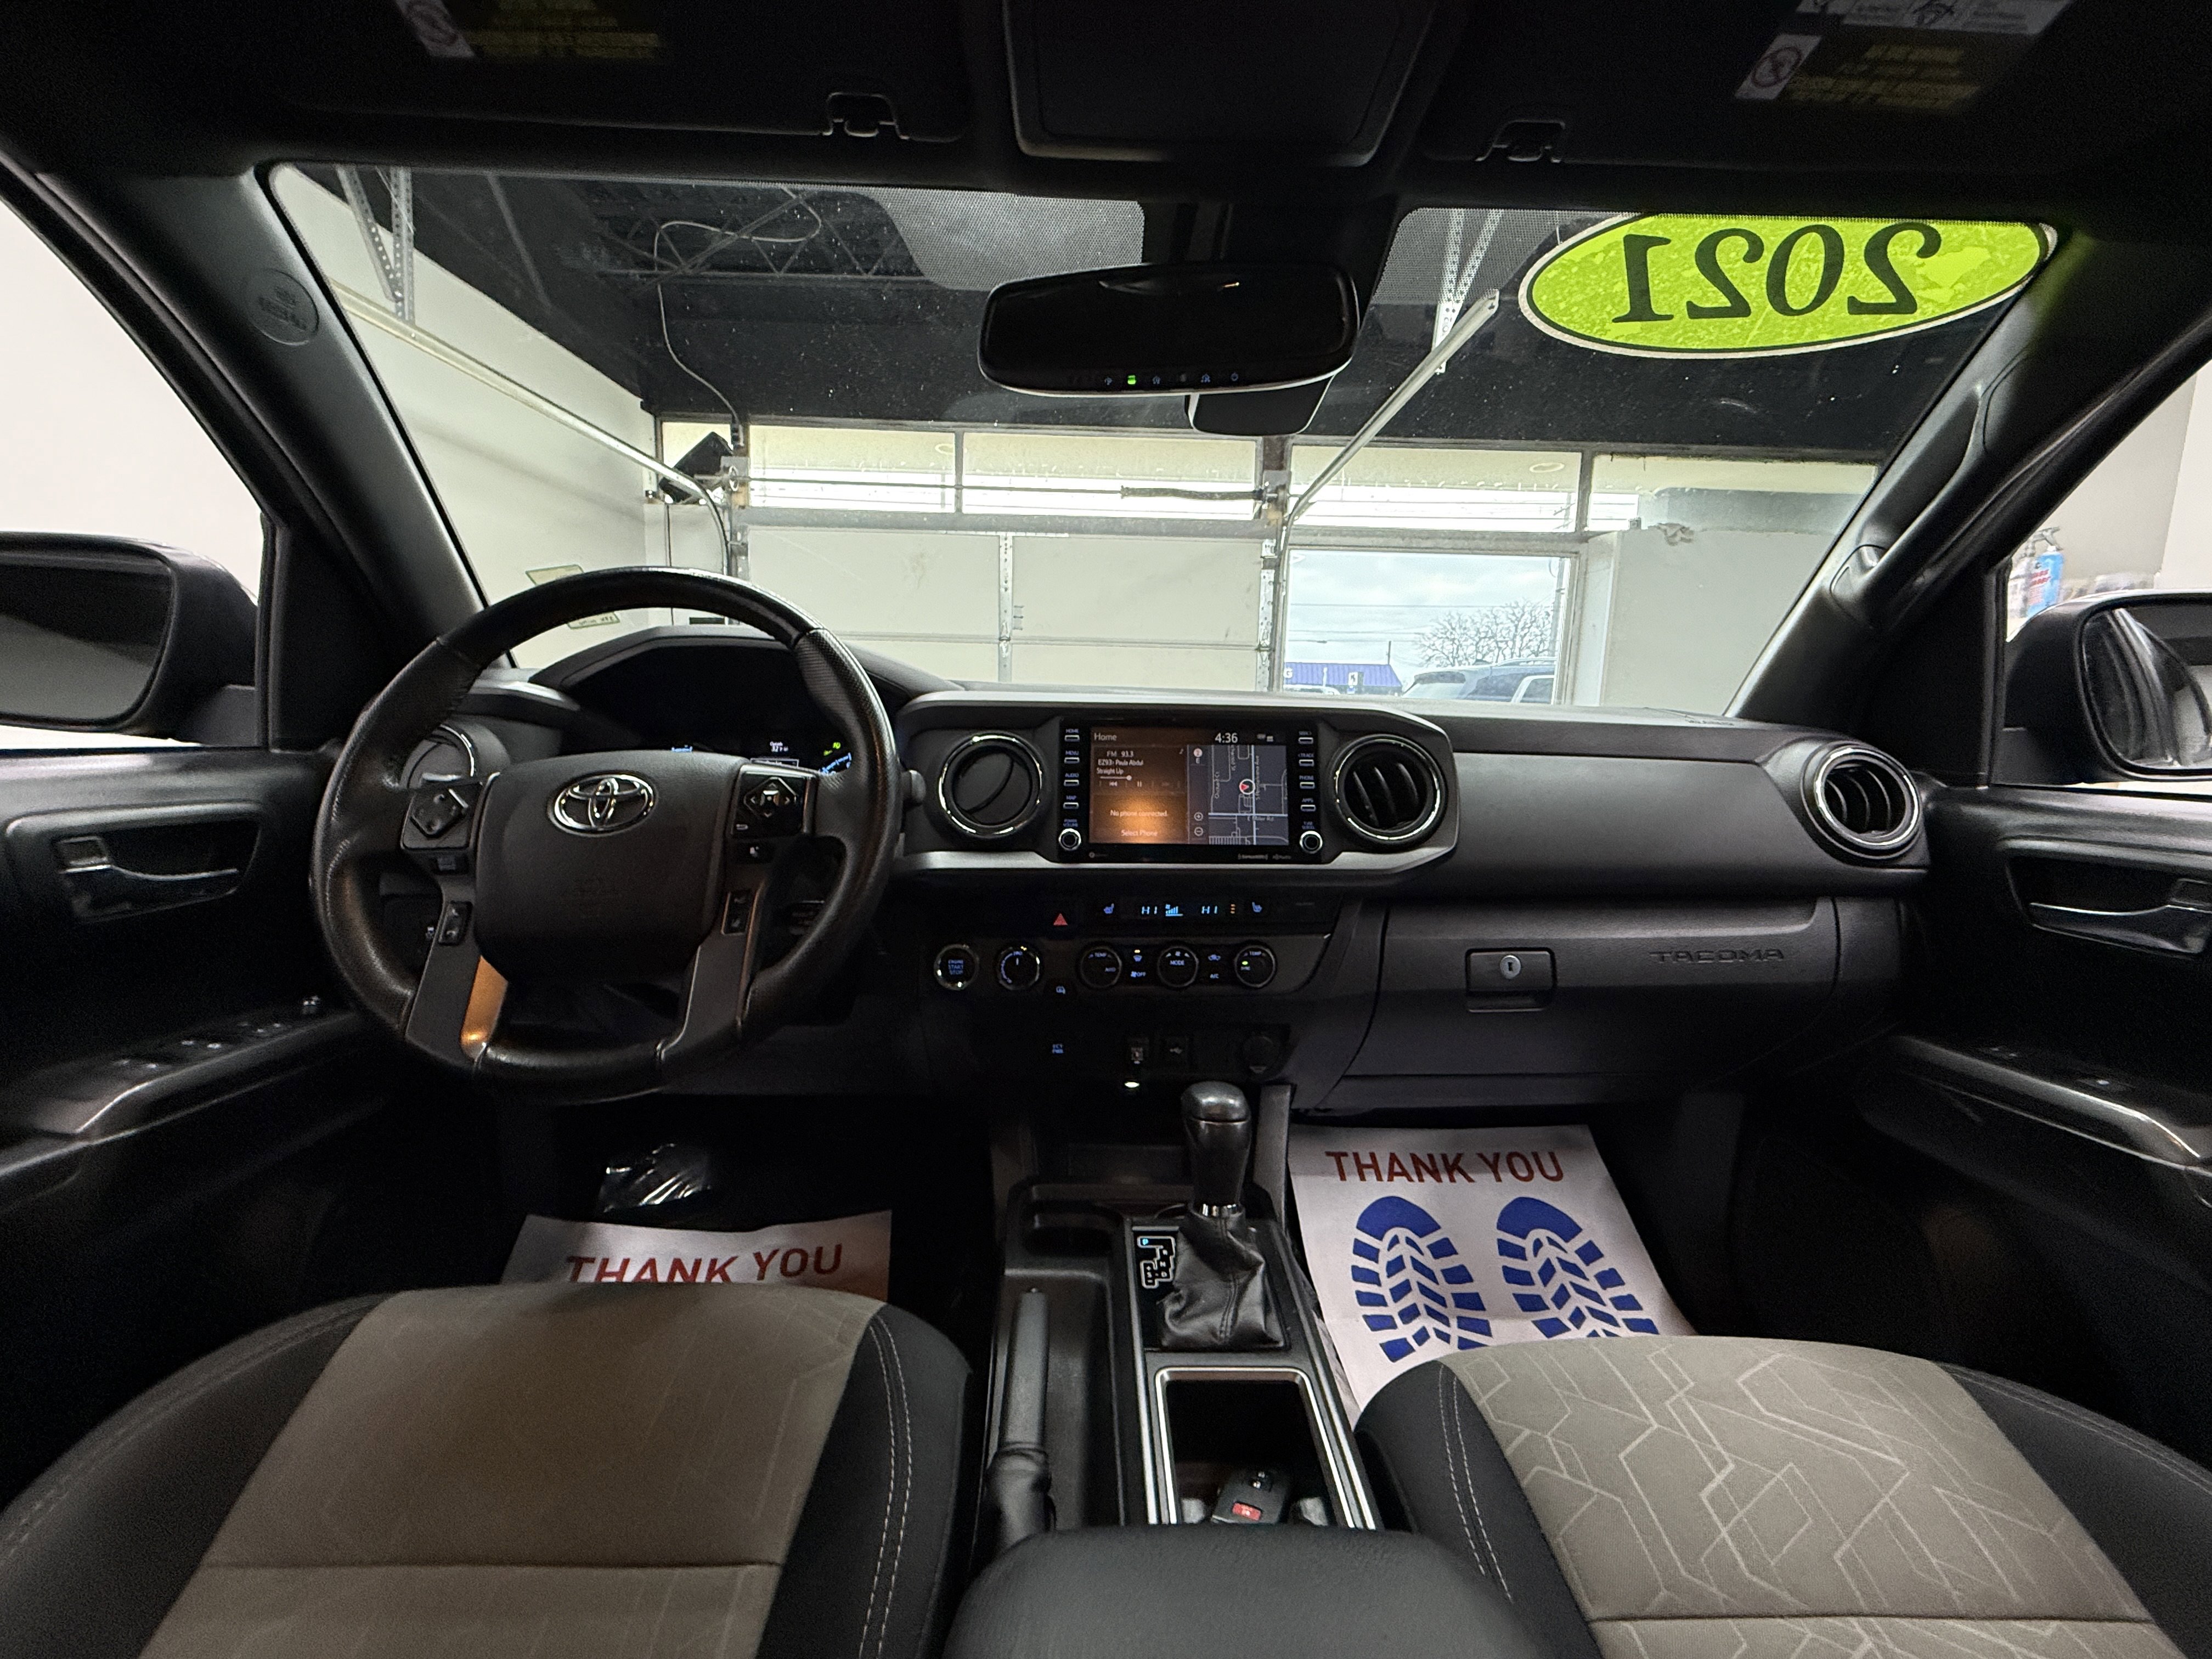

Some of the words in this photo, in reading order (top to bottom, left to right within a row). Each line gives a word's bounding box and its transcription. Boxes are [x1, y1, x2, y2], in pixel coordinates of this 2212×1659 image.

[1094, 733, 1117, 741] Home
[1215, 732, 1238, 743] 4:36
[1649, 949, 1784, 964] TACOMA
[1324, 1151, 1475, 1183] THANK
[1476, 1150, 1564, 1183] YOU
[567, 1255, 738, 1283] THANK
[753, 1244, 843, 1281] YOU
